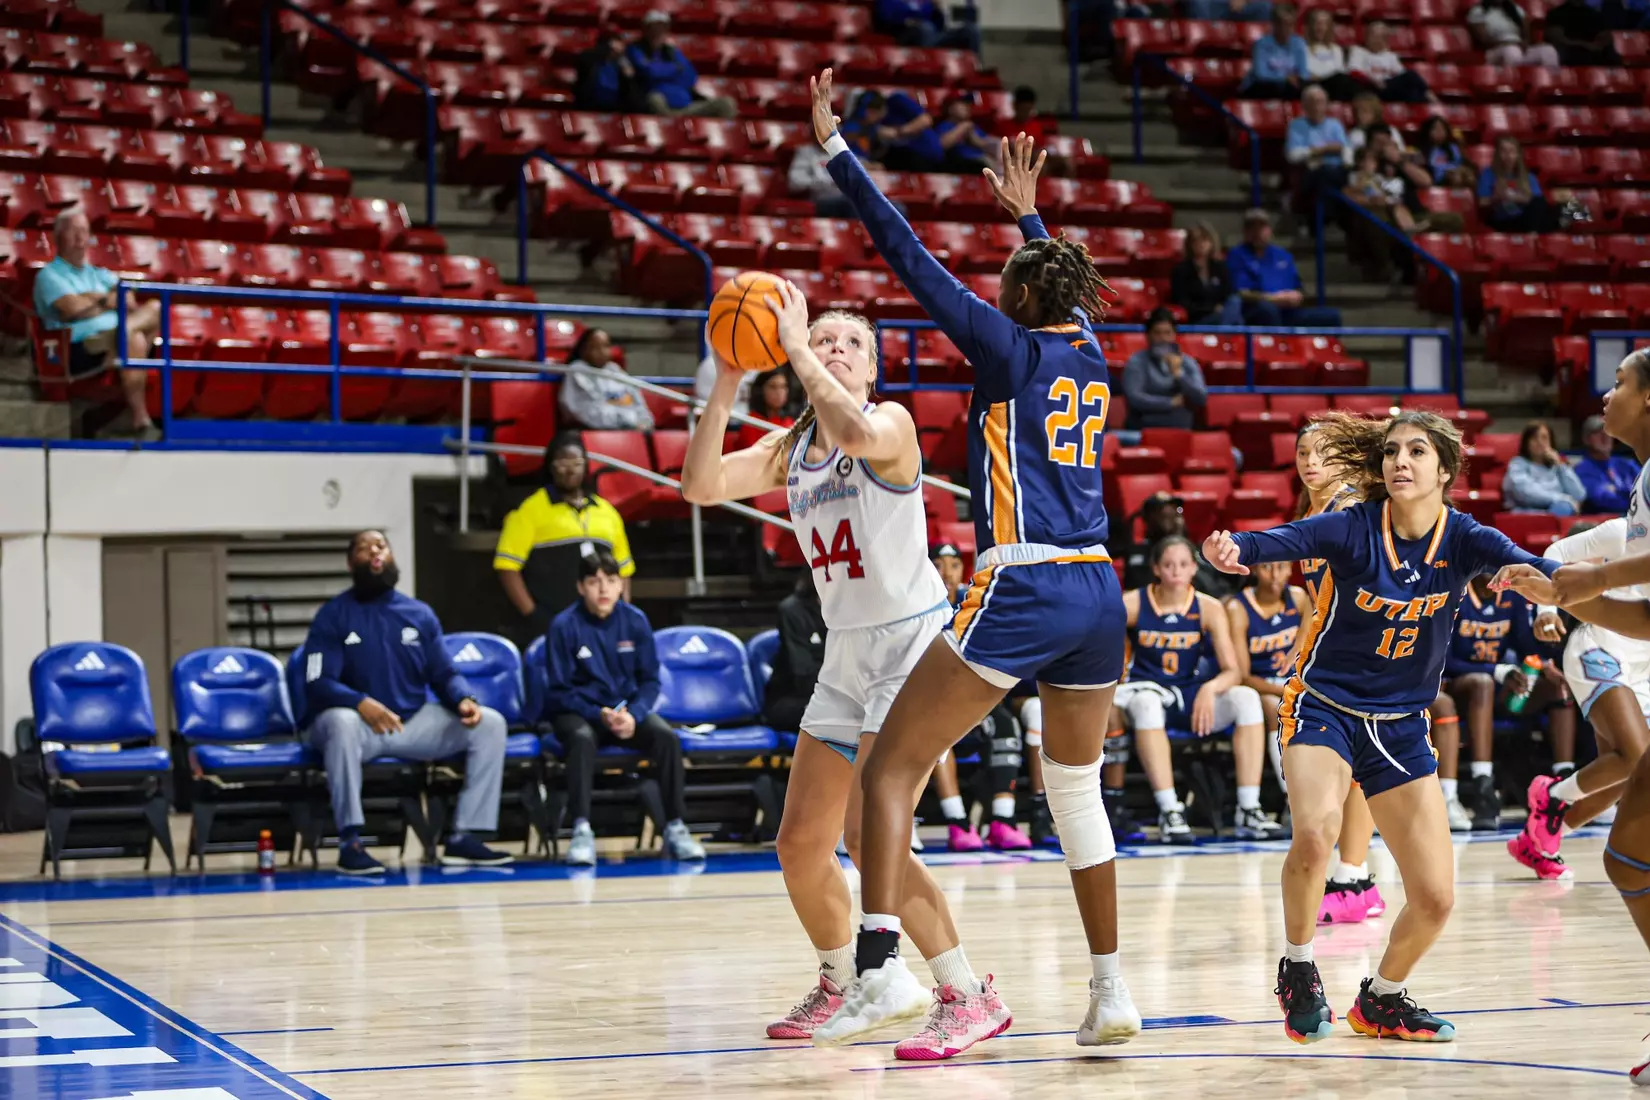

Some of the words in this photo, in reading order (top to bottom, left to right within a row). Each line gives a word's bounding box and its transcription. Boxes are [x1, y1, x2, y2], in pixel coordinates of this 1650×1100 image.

[1045, 376, 1111, 469] 22
[811, 518, 865, 583] 44
[1355, 587, 1450, 621] UTEP
[1138, 630, 1201, 649] UTEP
[1251, 625, 1300, 653] UTEP
[1375, 626, 1419, 660] 12
[1459, 619, 1511, 639] UTEP
[1161, 651, 1180, 676] 0
